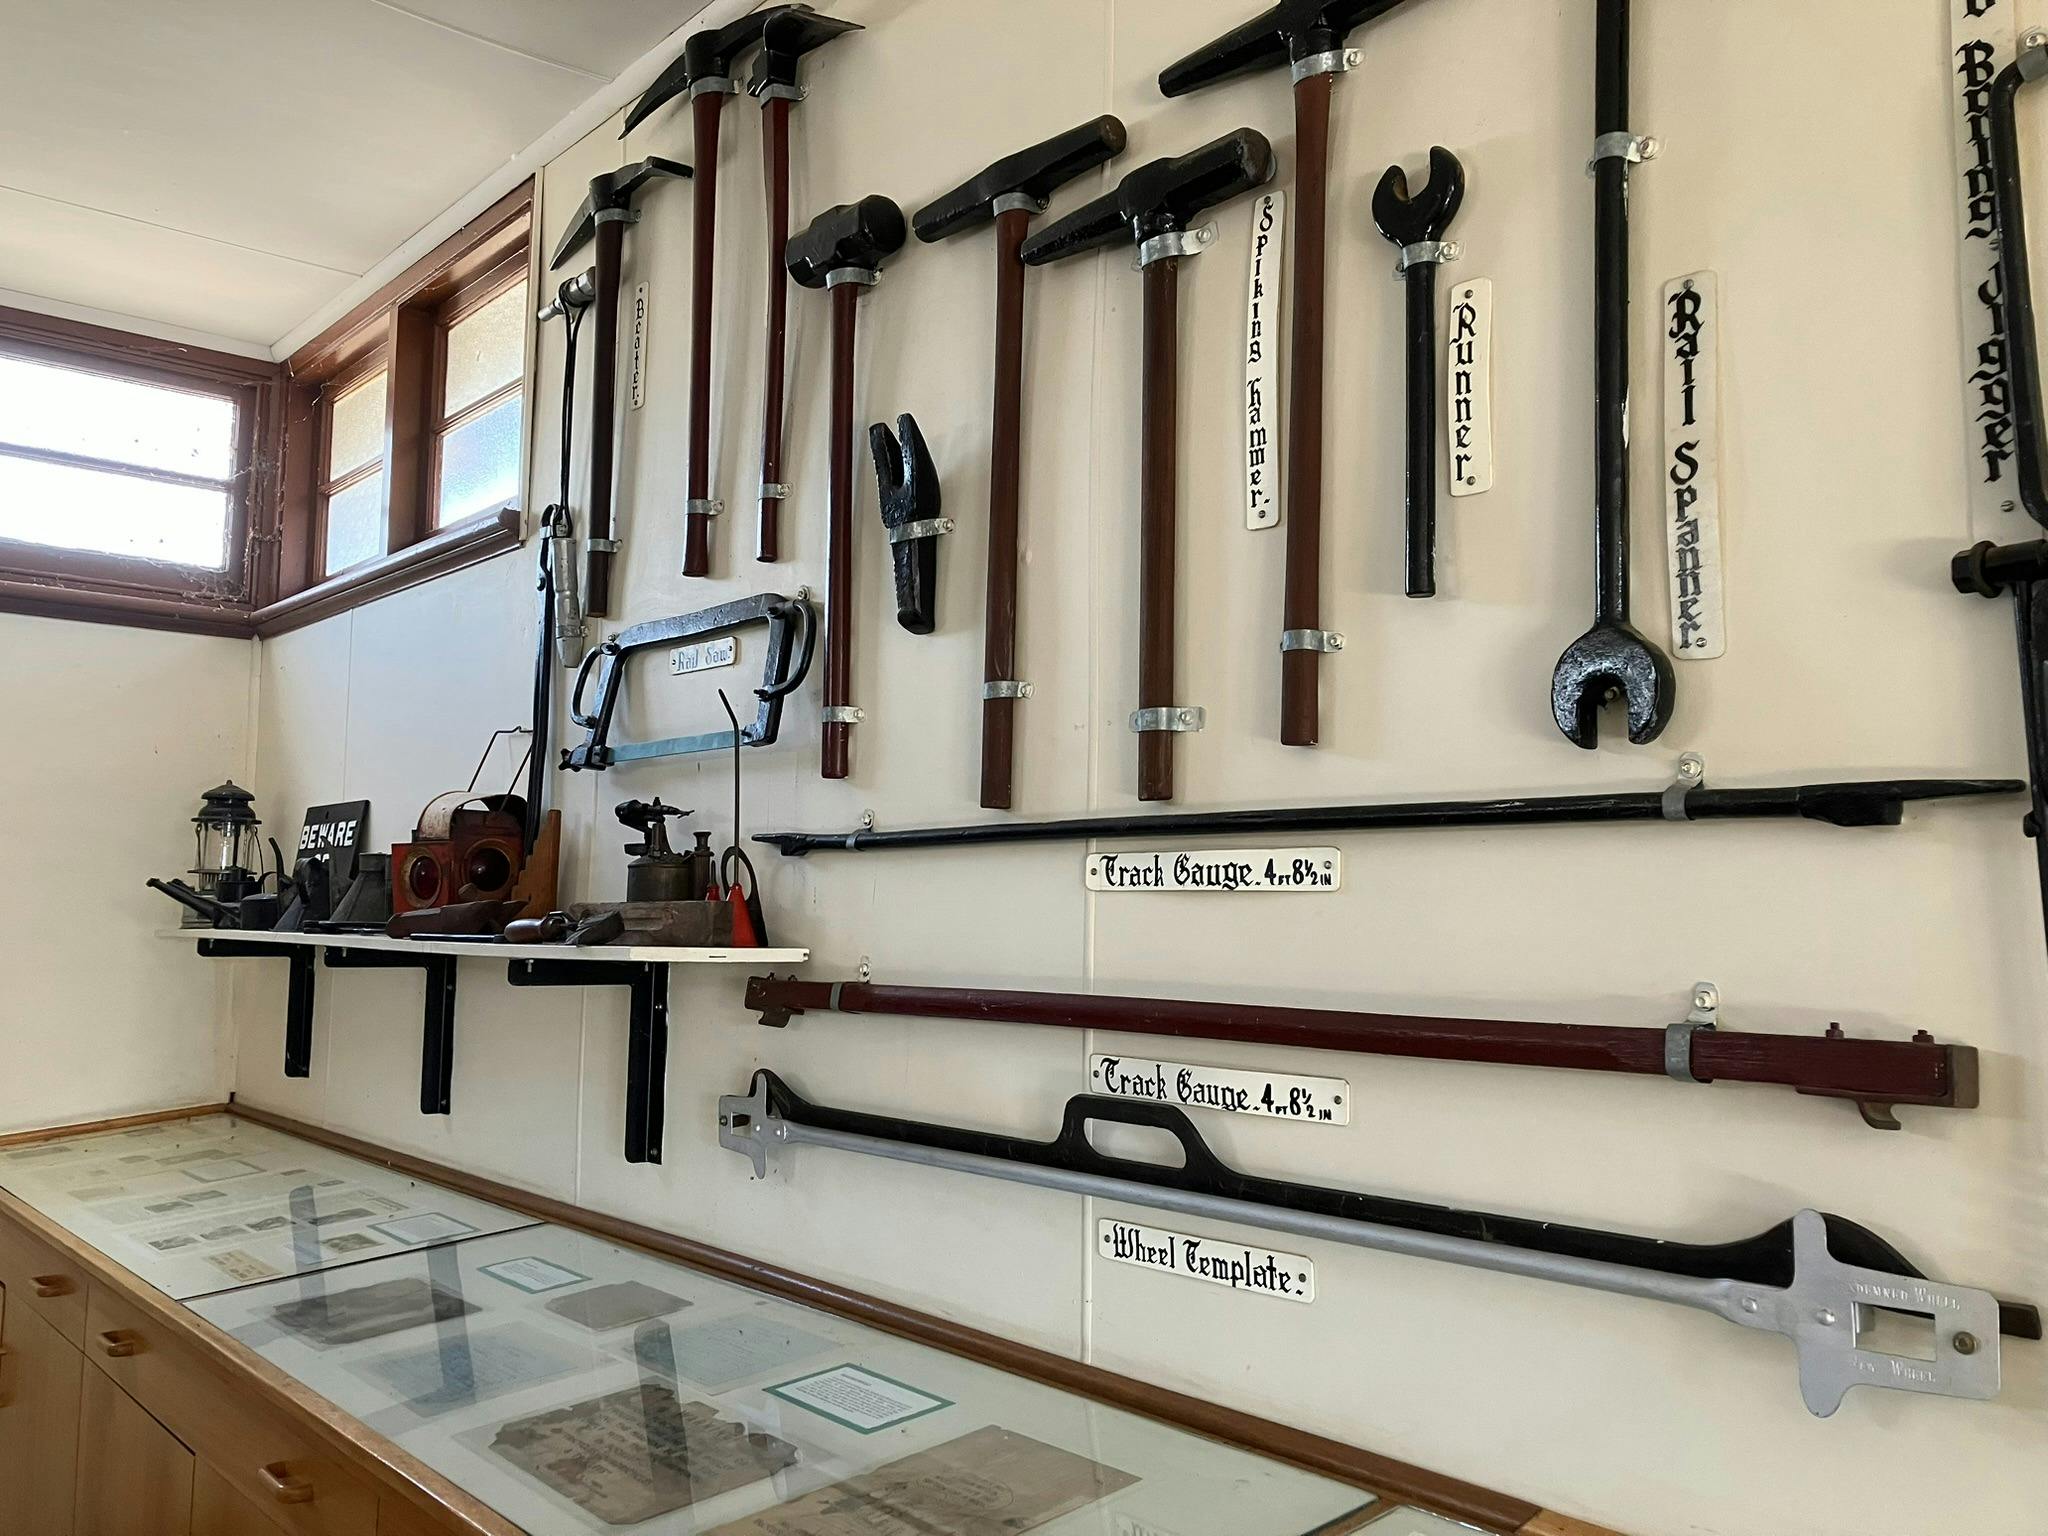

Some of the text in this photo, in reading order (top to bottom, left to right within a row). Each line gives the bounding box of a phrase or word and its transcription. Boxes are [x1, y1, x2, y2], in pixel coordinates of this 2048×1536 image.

[1248, 203, 1274, 364] Spiking
[1668, 286, 1705, 649] Rail Spanner
[299, 820, 357, 850] BEWARE
[1100, 854, 1164, 887] Track
[1100, 1057, 1168, 1100] Track
[1113, 1223, 1175, 1268] Wheel
